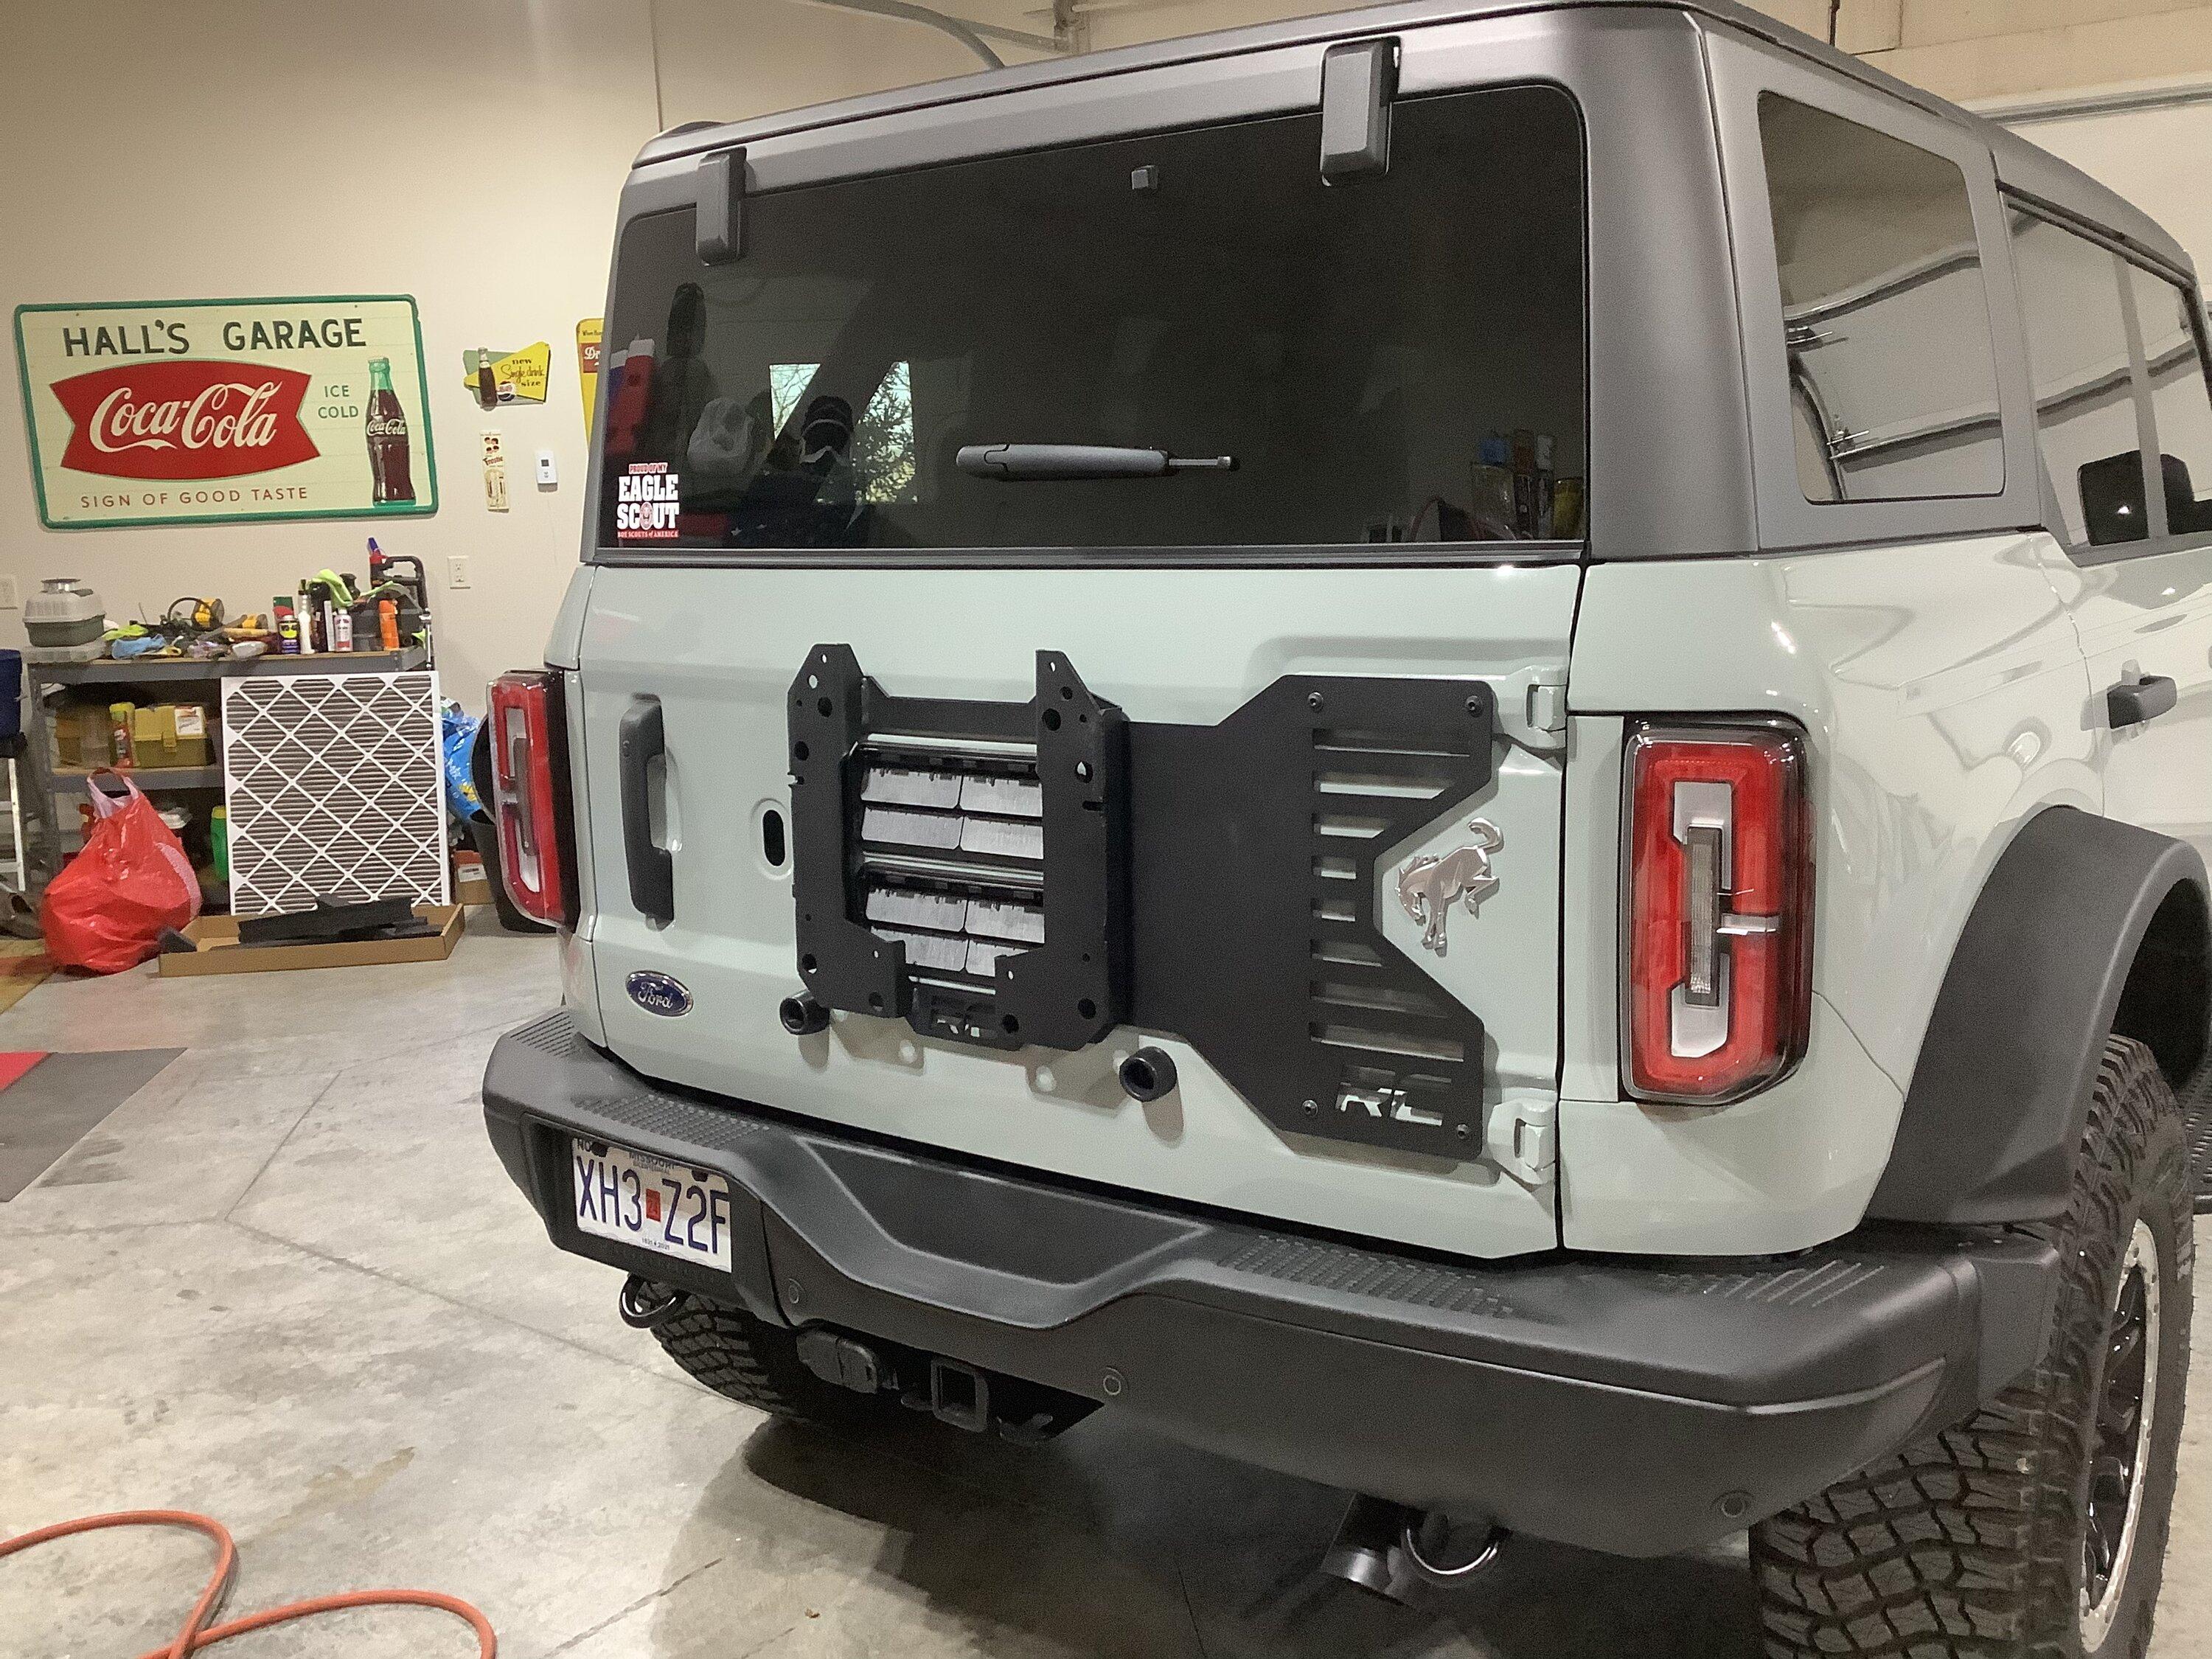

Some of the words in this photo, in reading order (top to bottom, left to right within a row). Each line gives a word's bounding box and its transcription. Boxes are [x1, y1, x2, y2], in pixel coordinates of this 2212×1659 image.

[63, 319, 190, 356] HALL'S
[223, 318, 366, 350] GARAGE
[324, 385, 350, 398] ICE
[89, 381, 282, 452] Coca-Cola
[318, 405, 359, 420] COLD
[649, 463, 656, 473] OF
[81, 495, 131, 508] SIGN
[142, 493, 168, 506] OF
[179, 490, 241, 504] GOOD
[251, 487, 308, 501] TASTE
[619, 474, 678, 501] EAGLE
[616, 502, 680, 530] SCOUT
[638, 981, 673, 1009] Ford
[629, 1152, 675, 1170] MISSOURI
[577, 1155, 642, 1231] XH3
[662, 1178, 730, 1254] Z2F
